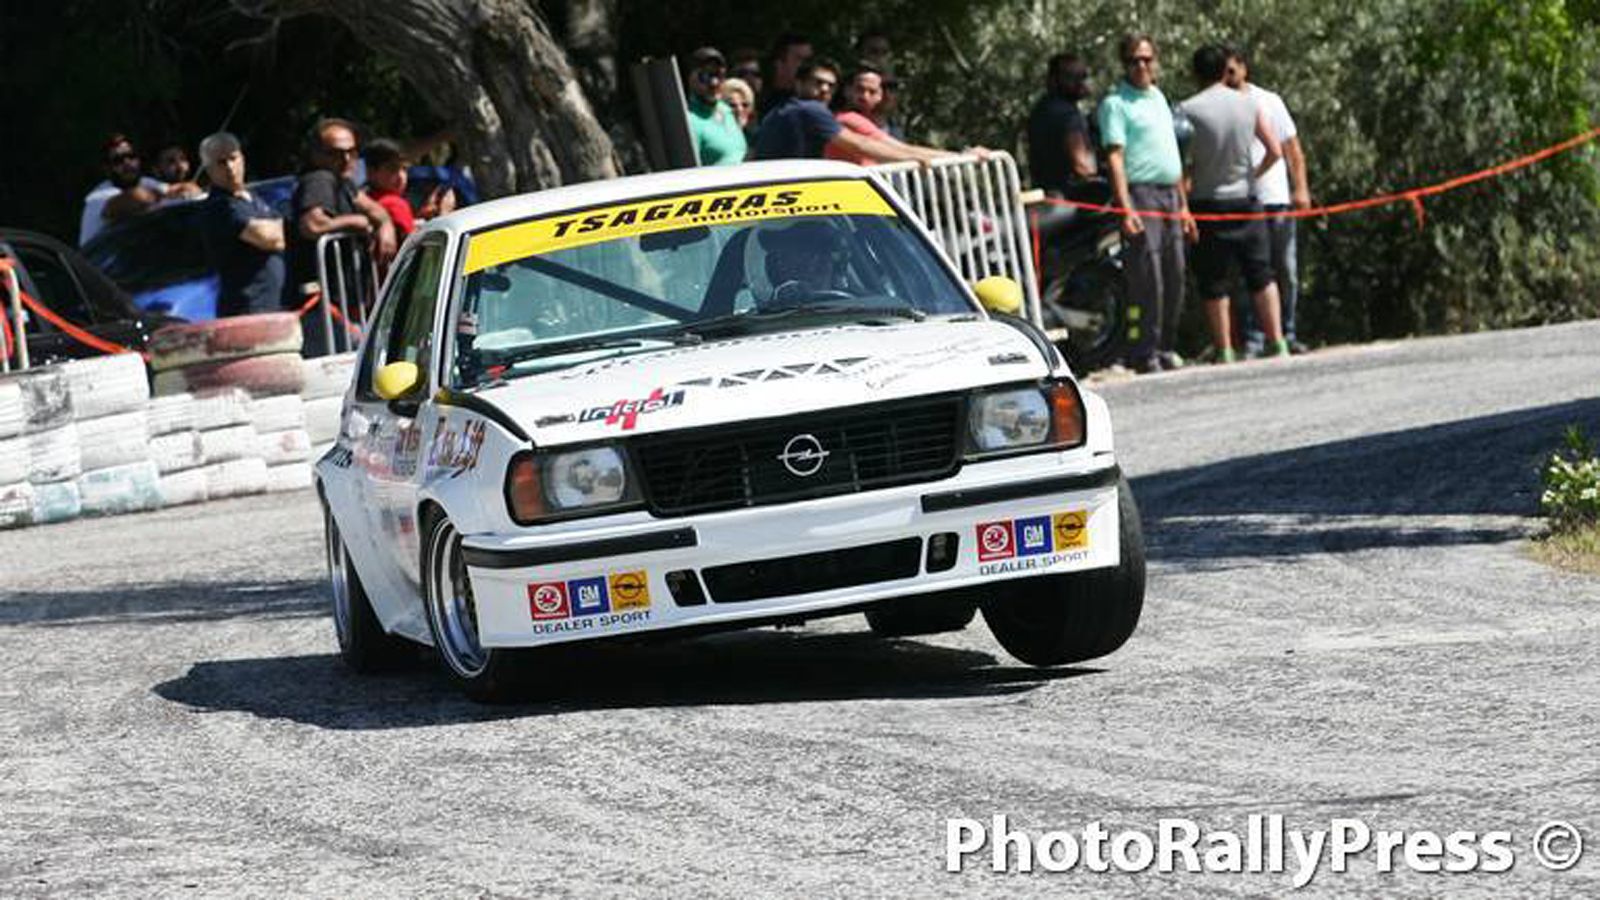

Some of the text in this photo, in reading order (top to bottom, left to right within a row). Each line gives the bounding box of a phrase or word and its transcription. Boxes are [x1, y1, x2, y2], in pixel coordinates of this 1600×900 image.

[553, 190, 804, 238] TSAGARAS
[690, 202, 843, 223] motorsport
[1024, 524, 1044, 546] GM
[980, 550, 1088, 576] DEALER SPORT
[578, 584, 600, 606] GM
[533, 610, 651, 634] DEALER SPORT
